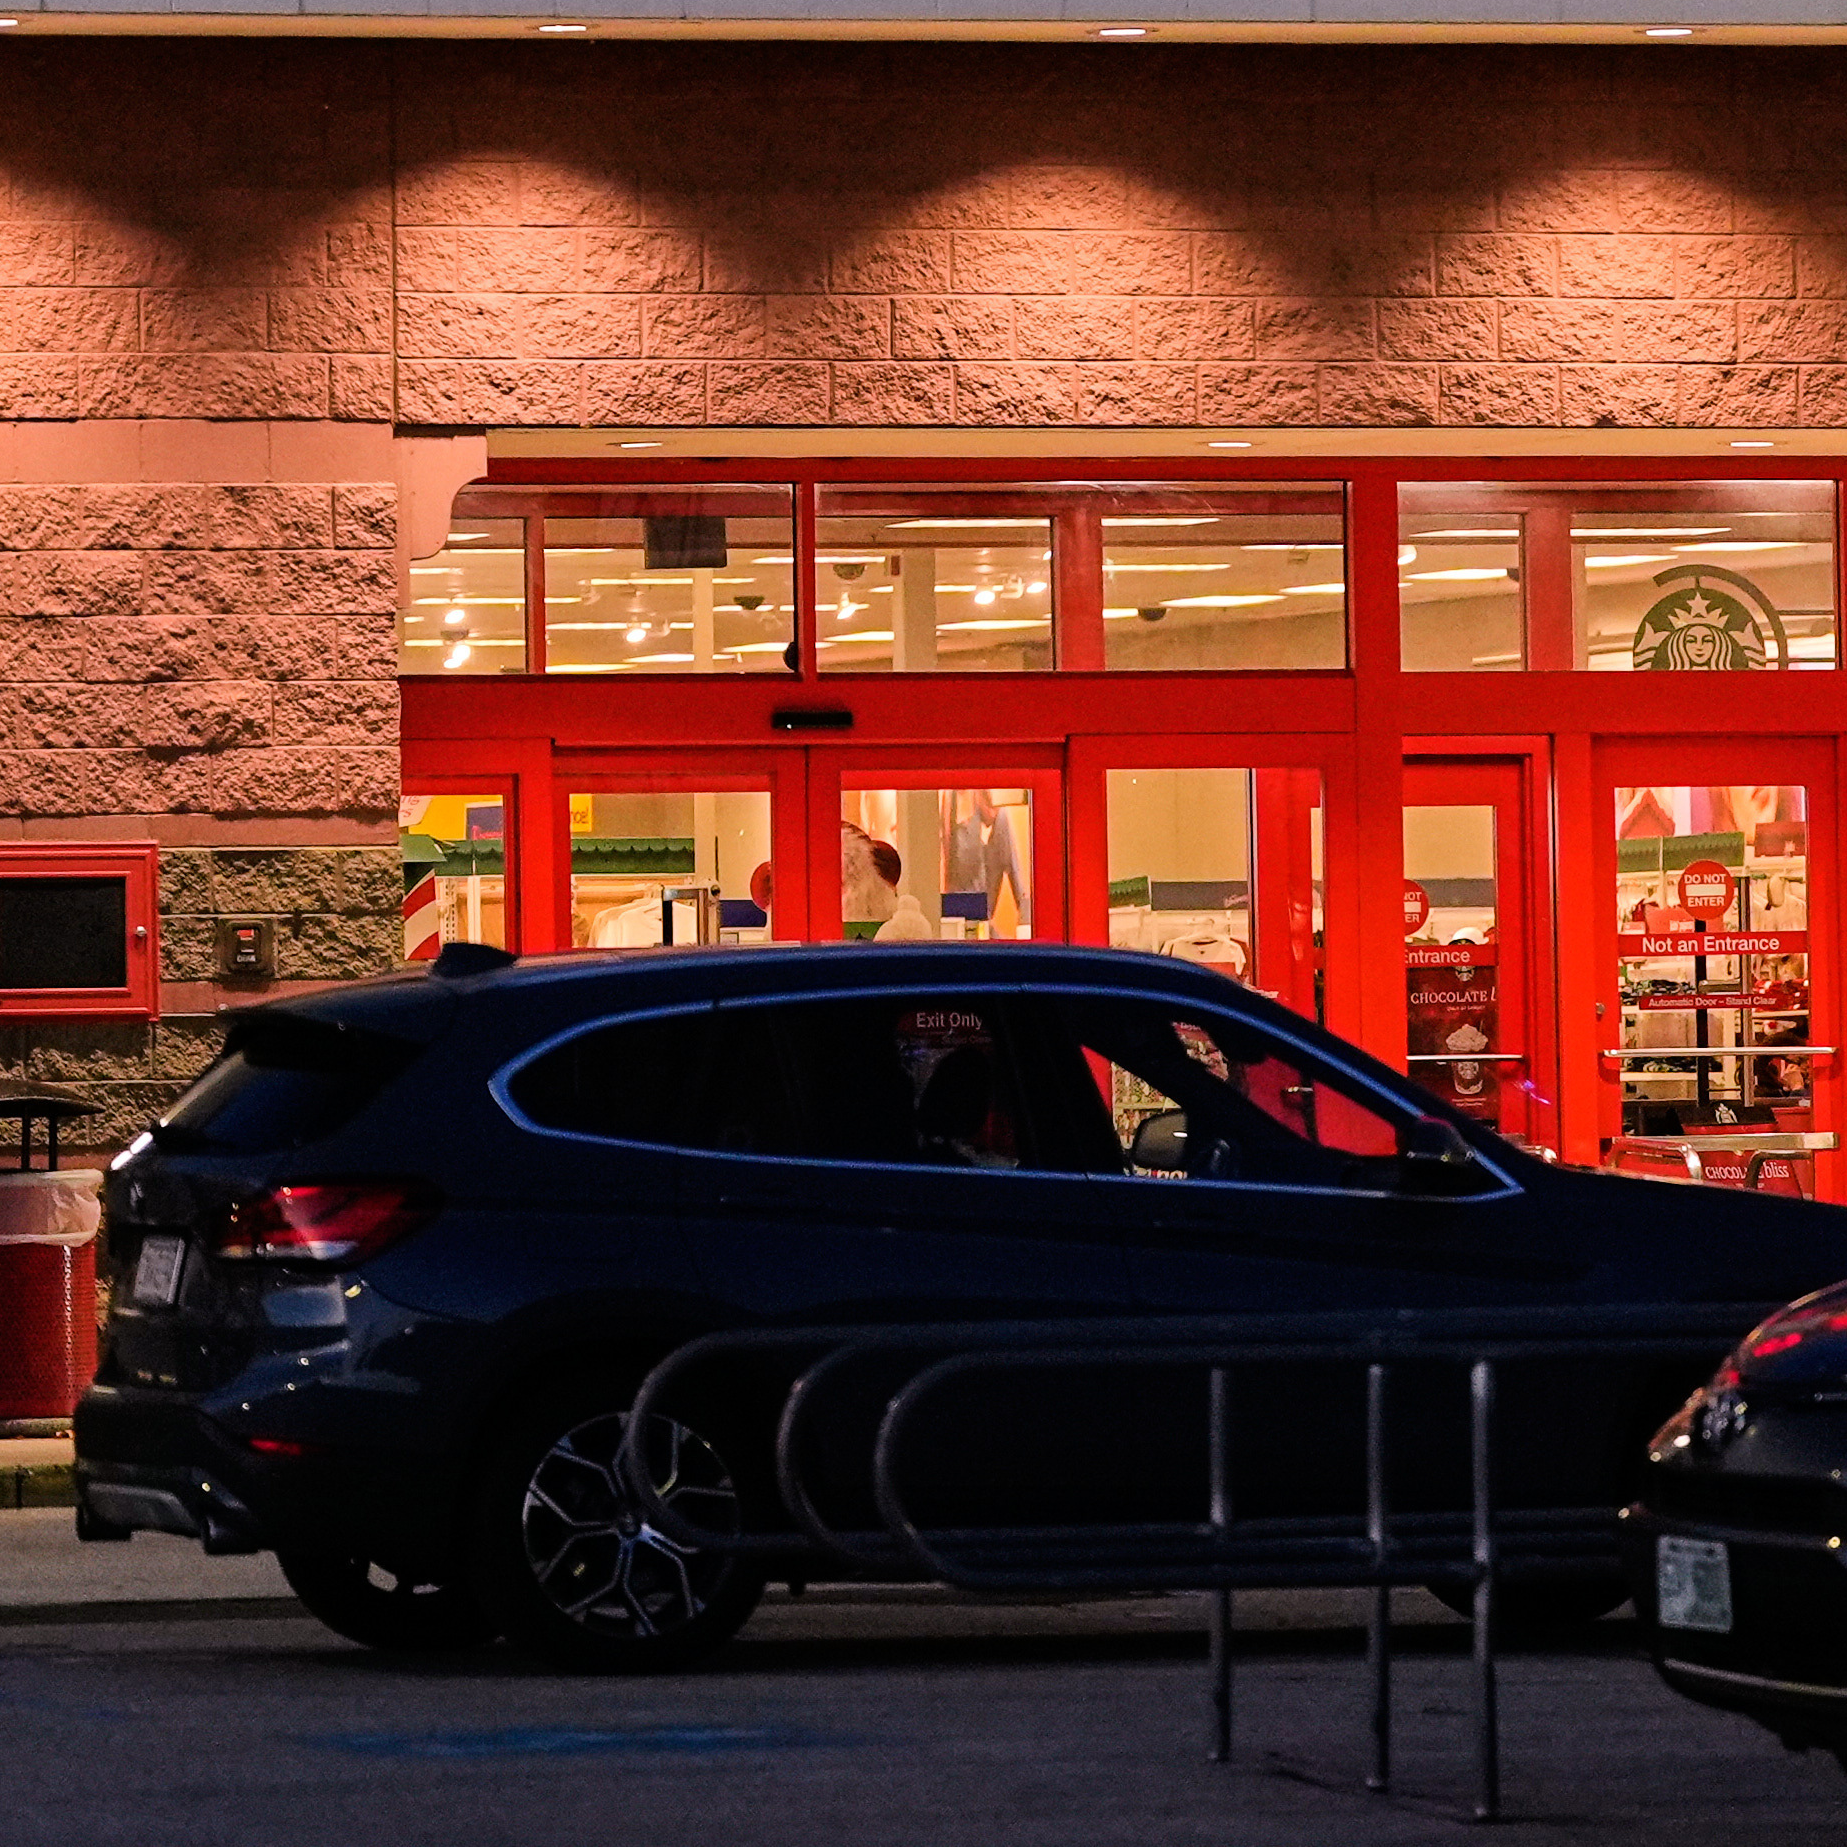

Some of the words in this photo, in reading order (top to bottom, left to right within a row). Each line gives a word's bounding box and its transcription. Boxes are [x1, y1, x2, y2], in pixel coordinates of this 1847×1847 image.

[1684, 874, 1701, 884] DO
[1703, 873, 1726, 883] NOT
[1687, 896, 1725, 907] ENTER
[1642, 937, 1673, 953] Not
[1677, 939, 1699, 953] an
[1703, 935, 1780, 952] Entrance
[1405, 949, 1471, 964] ntrance
[1410, 991, 1488, 1004] CHOCOLATE
[1695, 996, 1717, 1007] Door
[916, 1012, 945, 1028] Exit
[950, 1012, 982, 1030] Only
[1763, 1161, 1790, 1179] bliss
